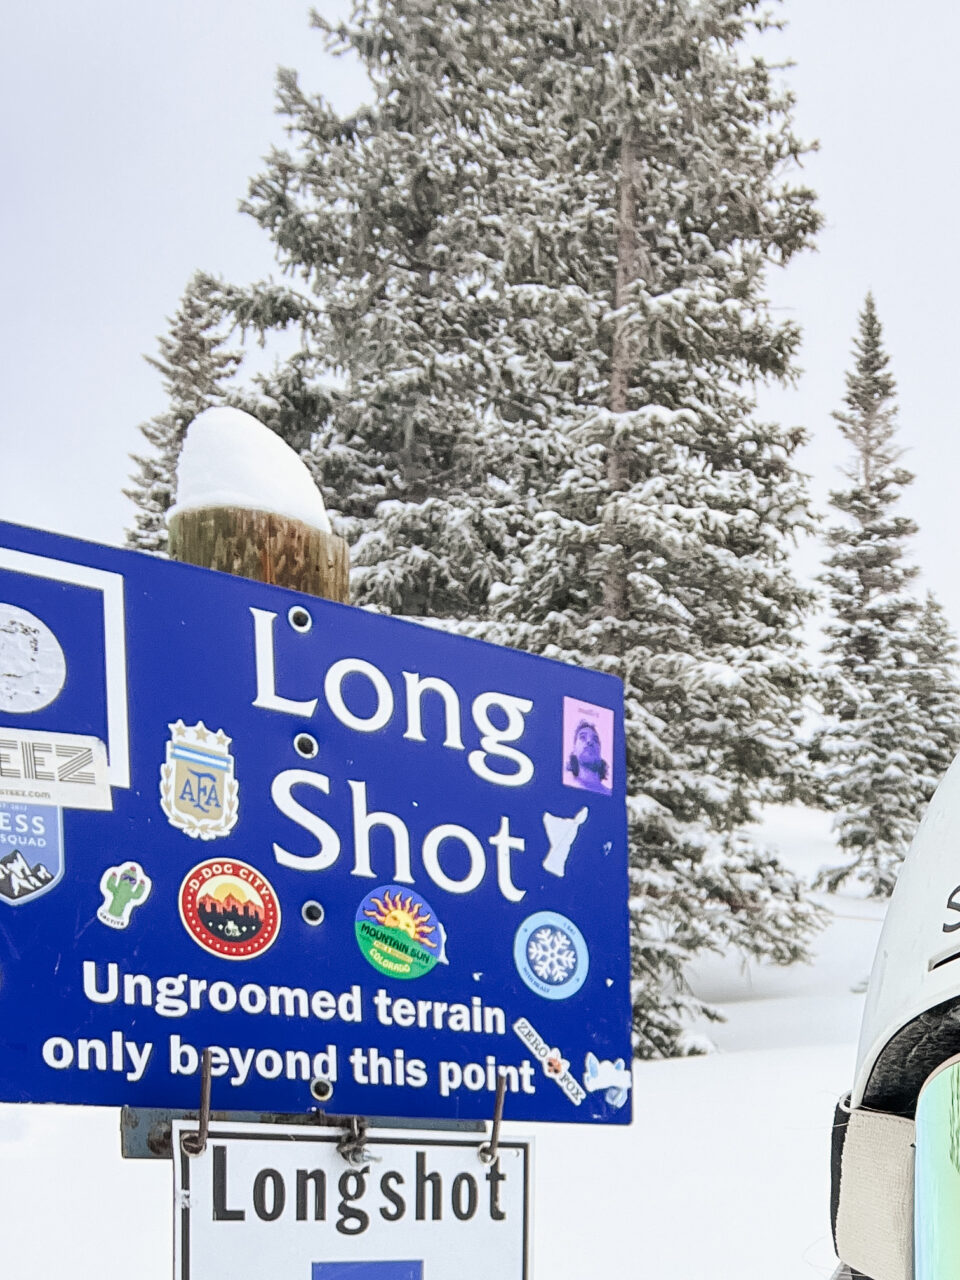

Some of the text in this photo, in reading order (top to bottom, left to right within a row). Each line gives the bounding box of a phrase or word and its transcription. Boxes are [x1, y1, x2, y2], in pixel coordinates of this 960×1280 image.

[249, 606, 535, 787] Long
[179, 767, 222, 813] AFA
[271, 768, 527, 902] Shot
[239, 868, 270, 895] CITY
[361, 923, 409, 954] MOUNTAIN
[410, 948, 430, 964] SUN
[369, 948, 411, 973] COLORADO
[83, 960, 506, 1034] Ungroomed terrain
[43, 1031, 536, 1097] only beyond this point
[517, 1021, 548, 1059] ZERO
[559, 1073, 584, 1101] FOX
[212, 1145, 506, 1235] Longshot
